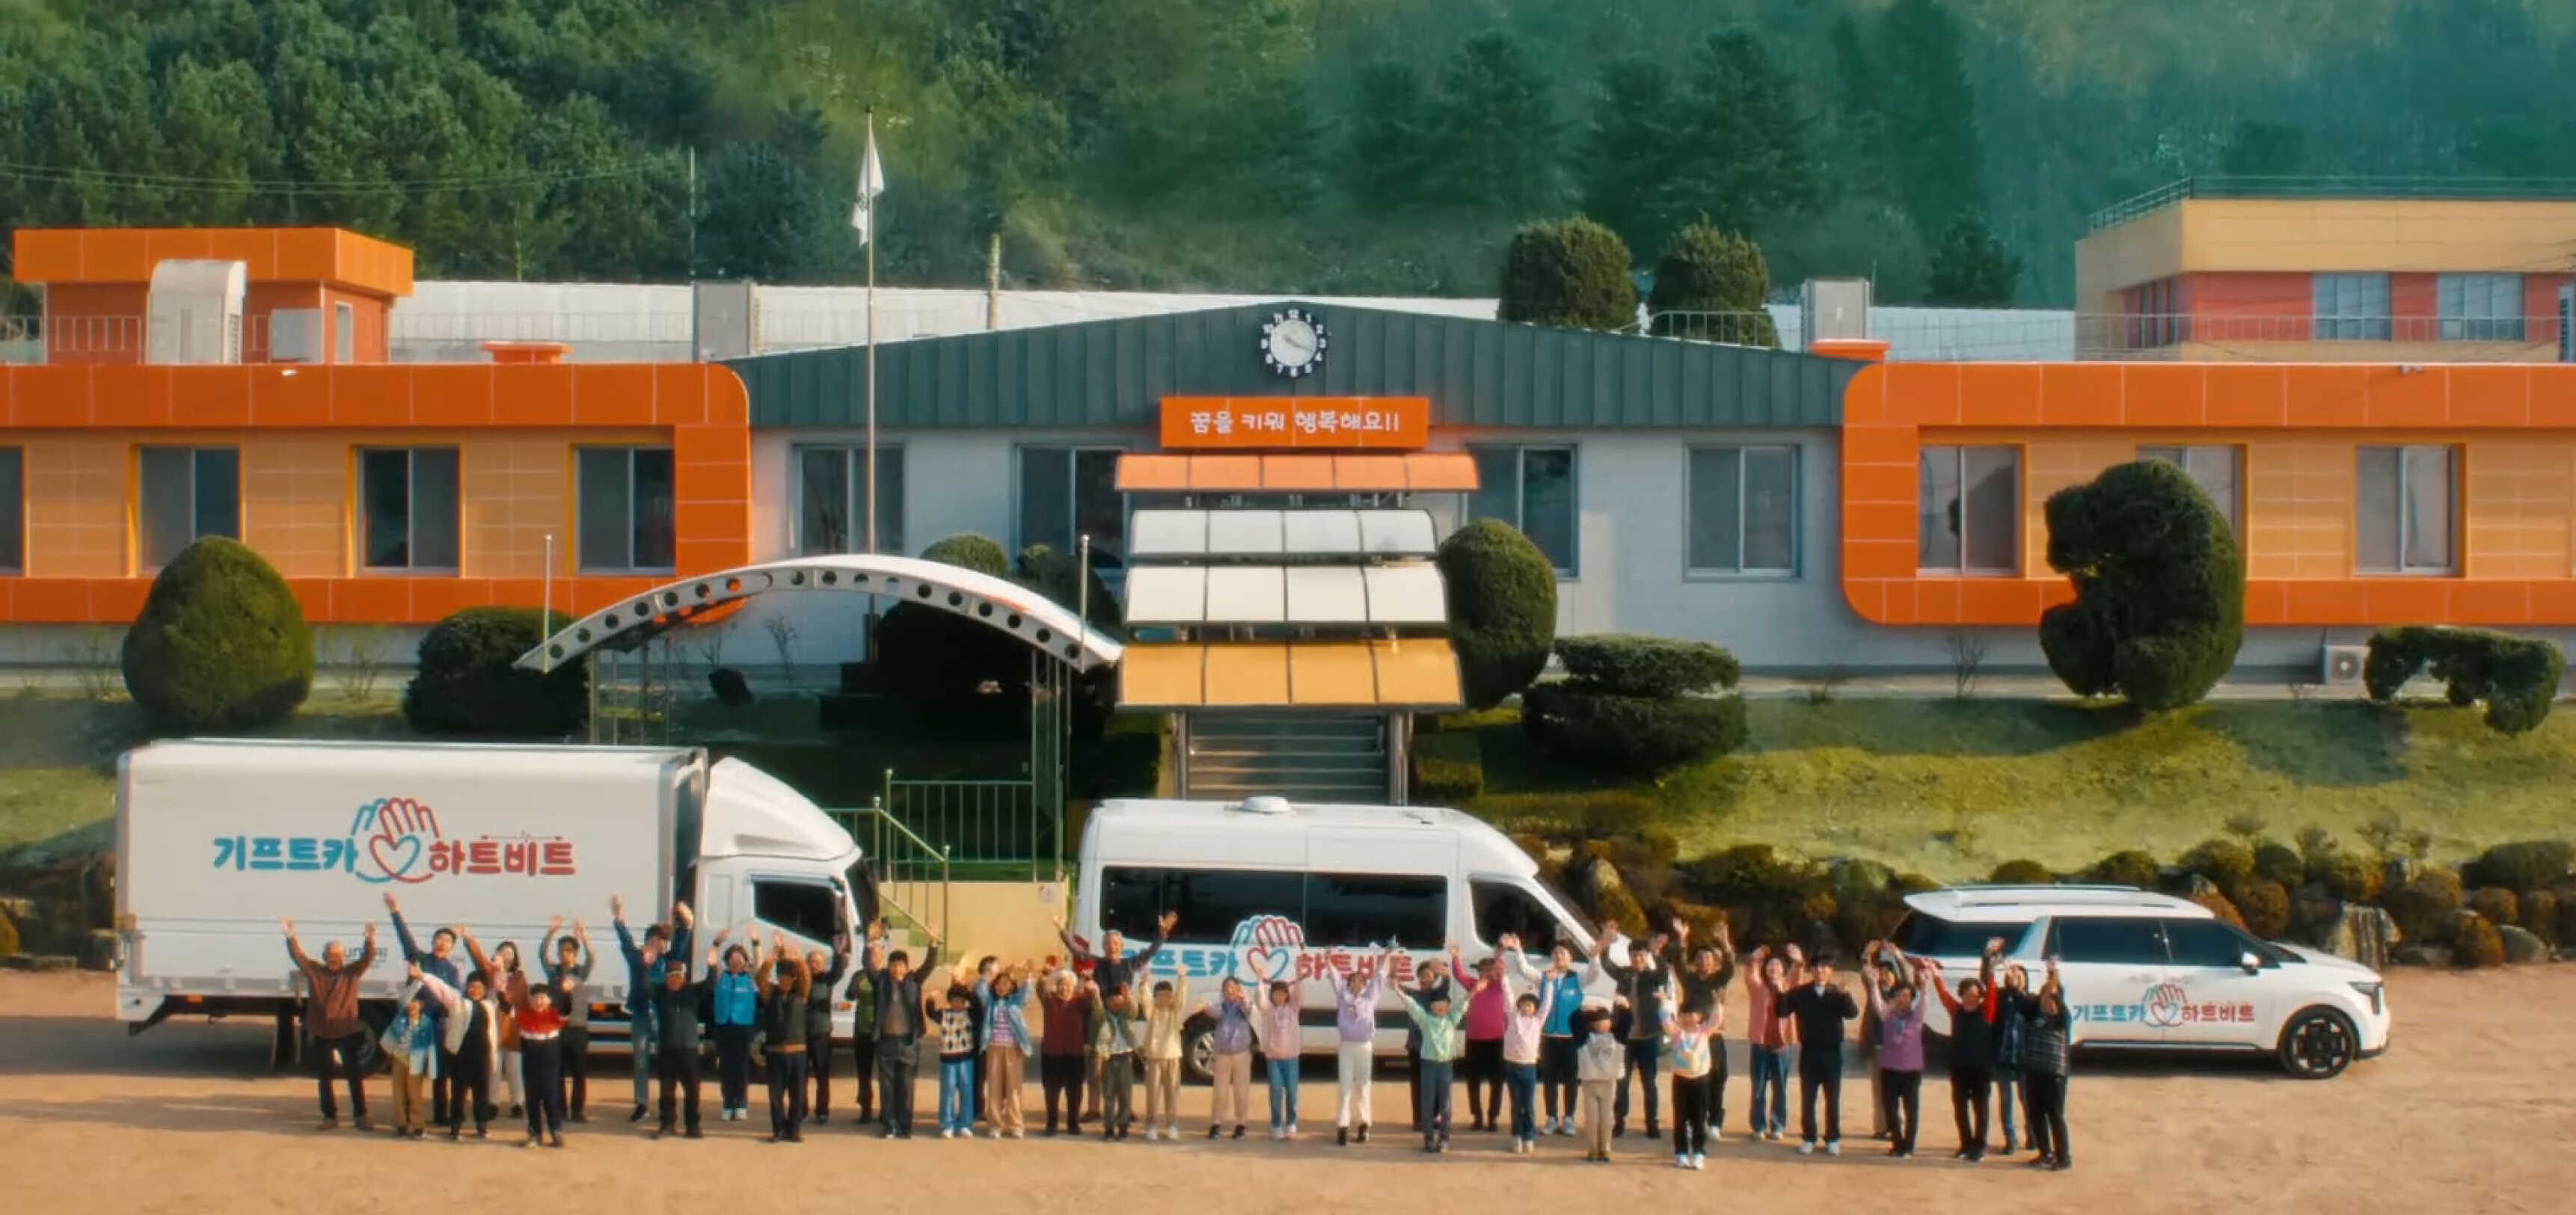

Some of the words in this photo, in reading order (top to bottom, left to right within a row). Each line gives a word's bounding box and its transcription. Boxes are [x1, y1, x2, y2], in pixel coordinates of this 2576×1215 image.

[1190, 410, 1234, 434] 꿈을
[1240, 411, 1285, 432] 키워
[213, 834, 359, 874] 기프트카
[429, 838, 577, 877] 하트비트
[2072, 1003, 2147, 1024] 기프트카
[2180, 1003, 2256, 1024] 하트비트
